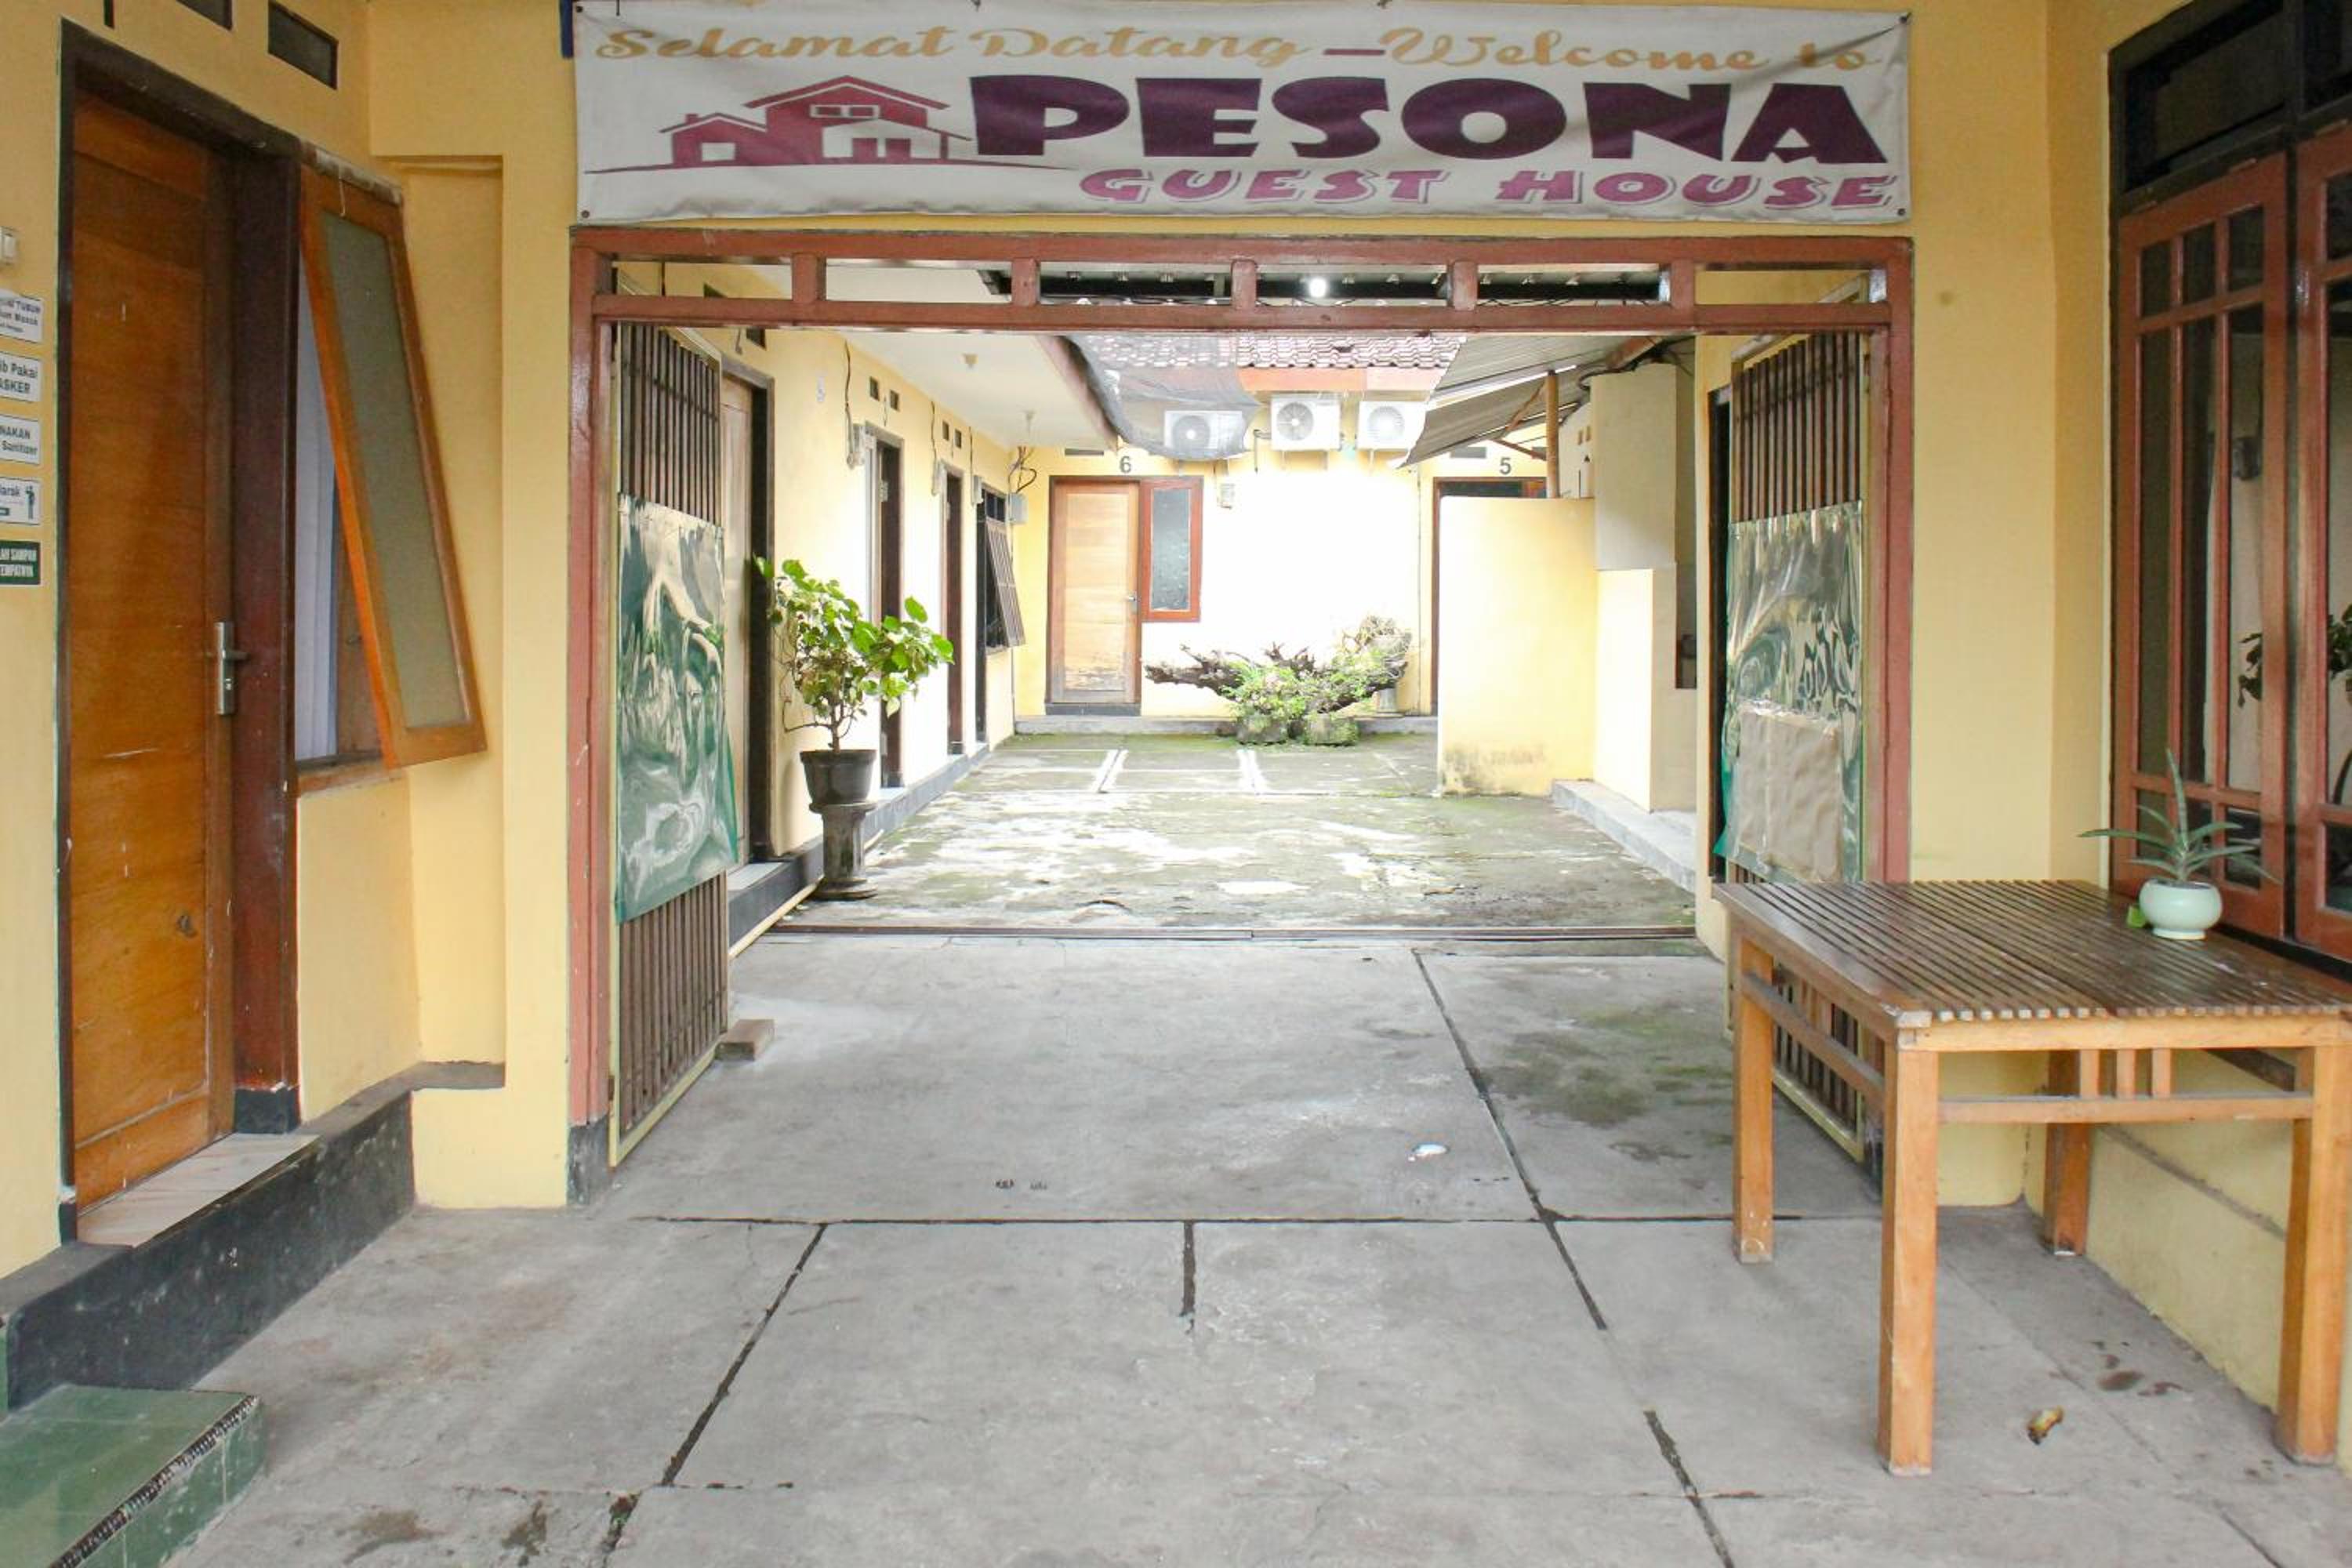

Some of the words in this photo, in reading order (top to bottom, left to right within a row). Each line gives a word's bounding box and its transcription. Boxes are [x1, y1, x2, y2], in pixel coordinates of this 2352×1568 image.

[595, 26, 958, 59] Selamat
[967, 26, 1311, 68] Datang
[1379, 27, 1769, 71] Welcome
[1794, 42, 1882, 71] to
[969, 74, 1889, 164] PESONA
[1079, 169, 1450, 204] GUEST
[1498, 169, 1898, 210] HOUSE
[11, 362, 38, 379] Pakai
[1120, 456, 1132, 474] 6
[1499, 456, 1512, 475] 5
